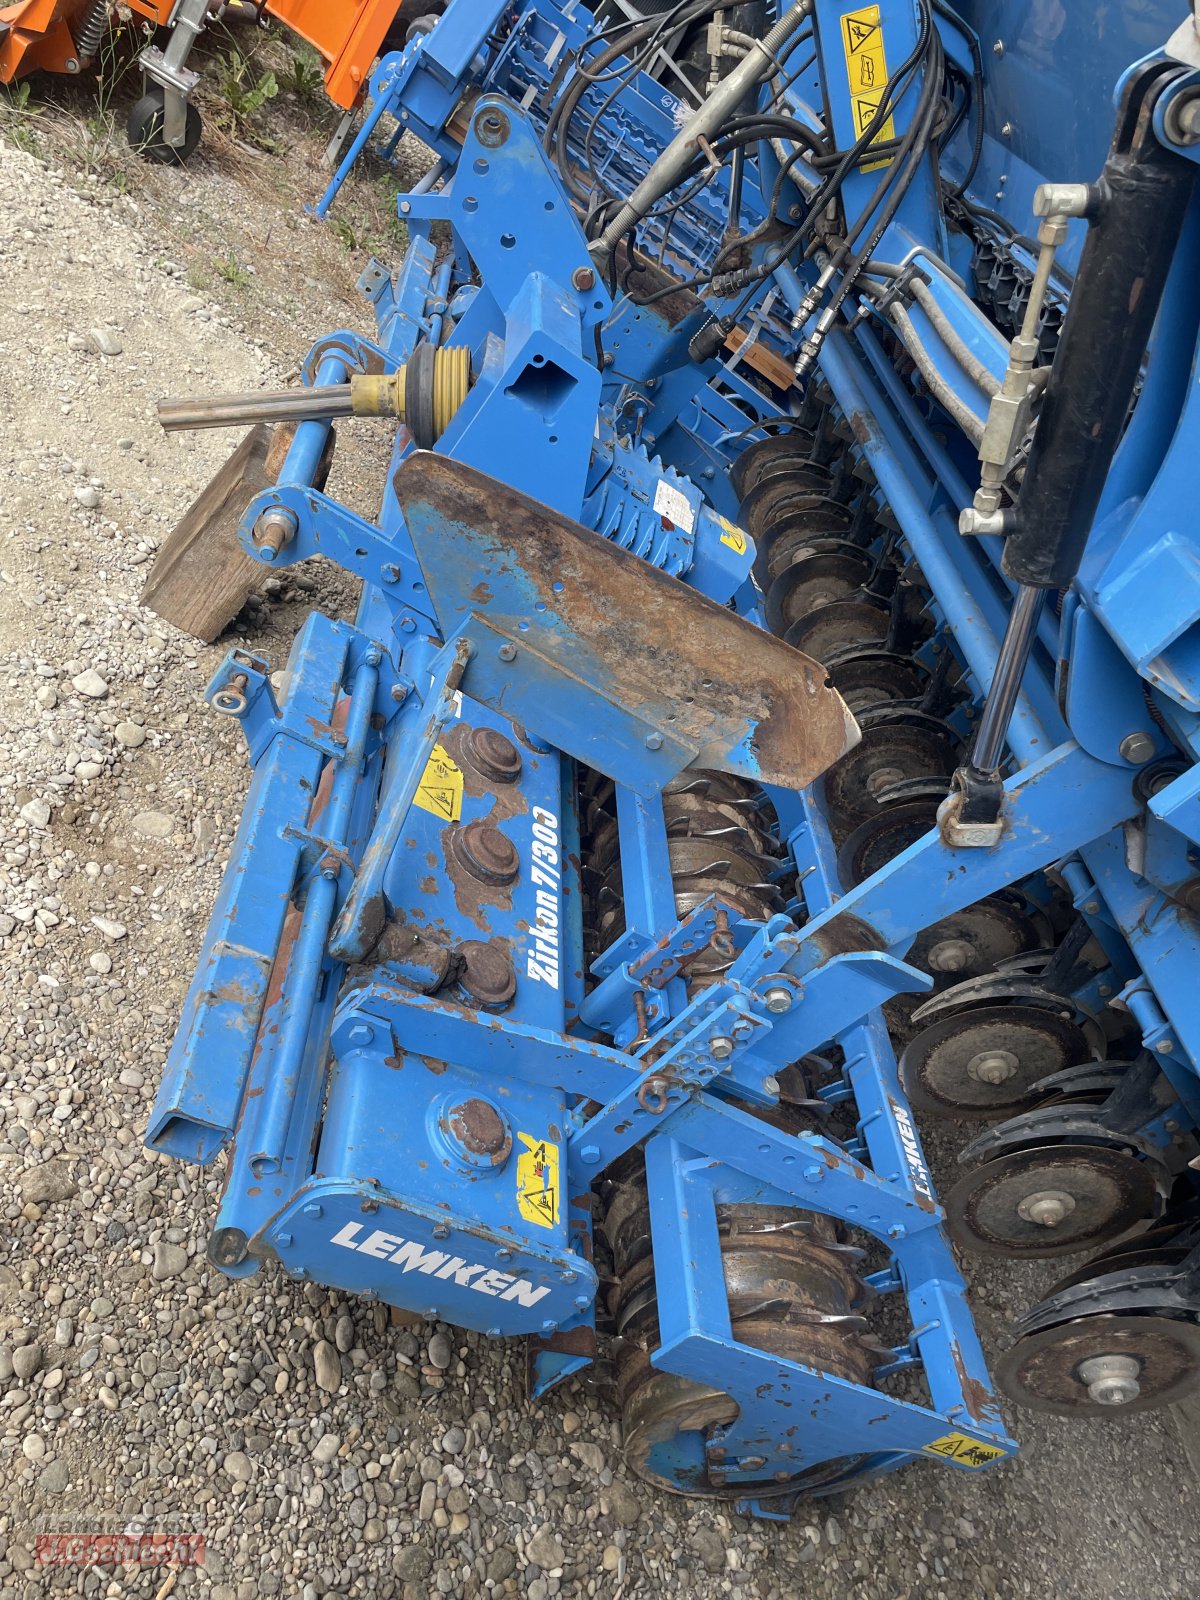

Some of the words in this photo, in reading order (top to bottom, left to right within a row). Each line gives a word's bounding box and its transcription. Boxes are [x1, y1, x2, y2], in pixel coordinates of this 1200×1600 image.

[531, 805, 560, 891] 7/300
[527, 889, 559, 990] Zirkon
[330, 1221, 551, 1308] LEMKEN
